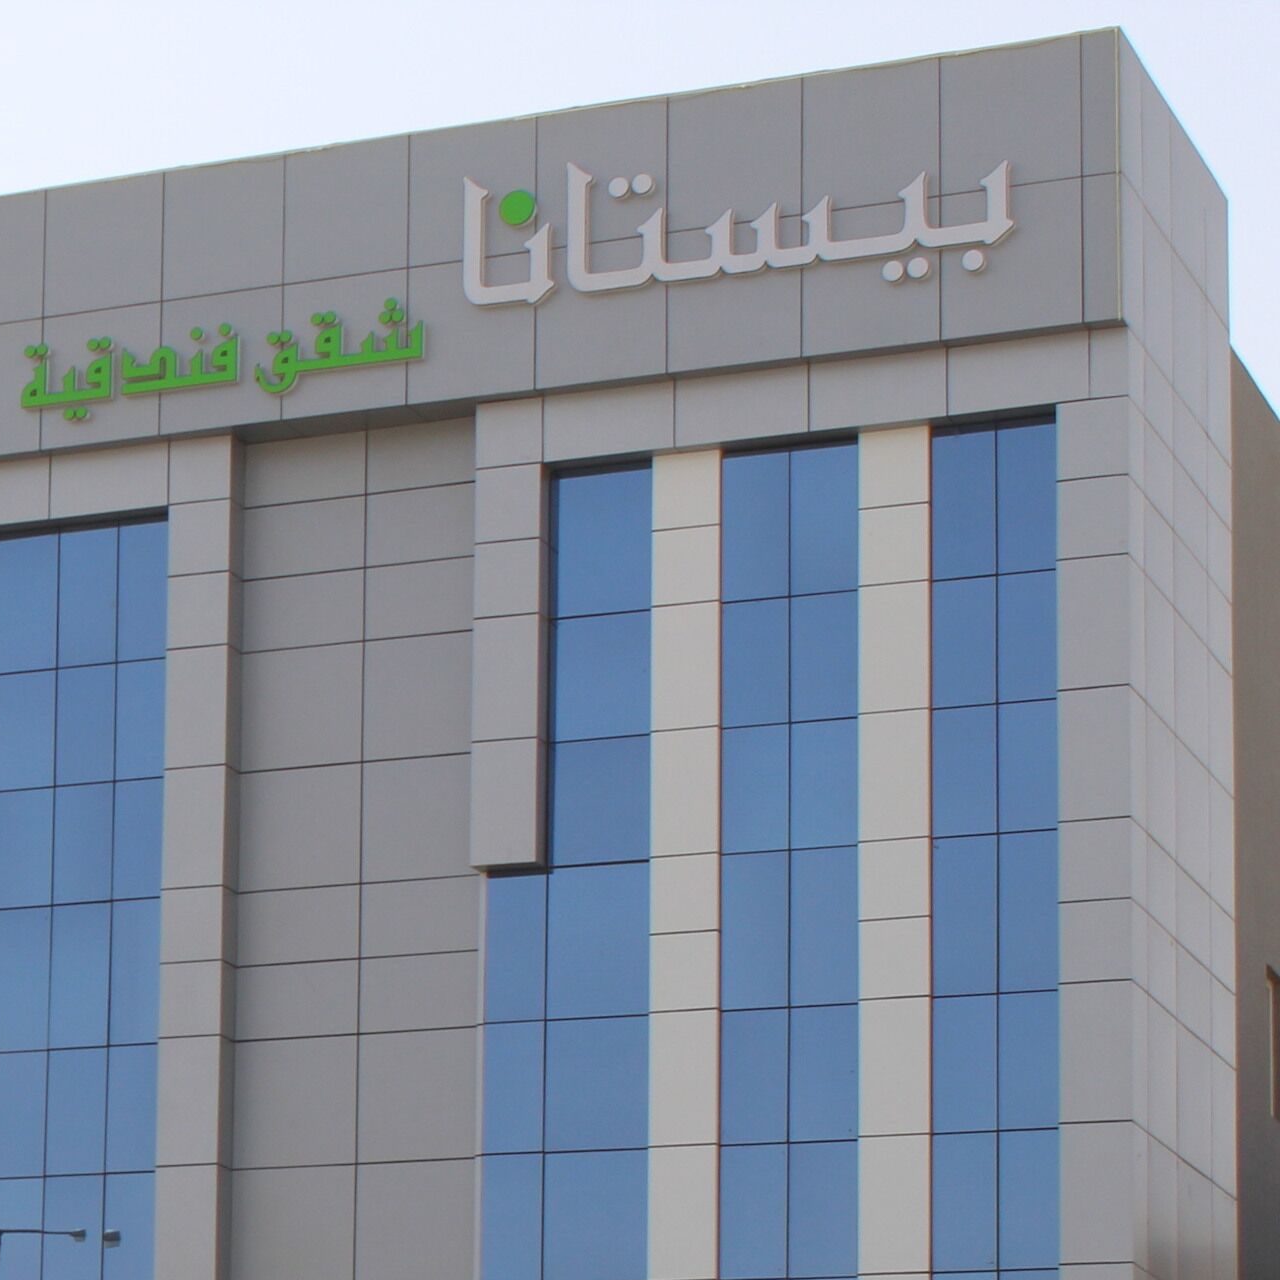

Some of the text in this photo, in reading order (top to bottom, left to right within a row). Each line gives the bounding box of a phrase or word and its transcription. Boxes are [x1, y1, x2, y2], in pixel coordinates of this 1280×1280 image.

[462, 159, 1015, 306] بيستانا
[20, 297, 426, 422] شقق فندقية
